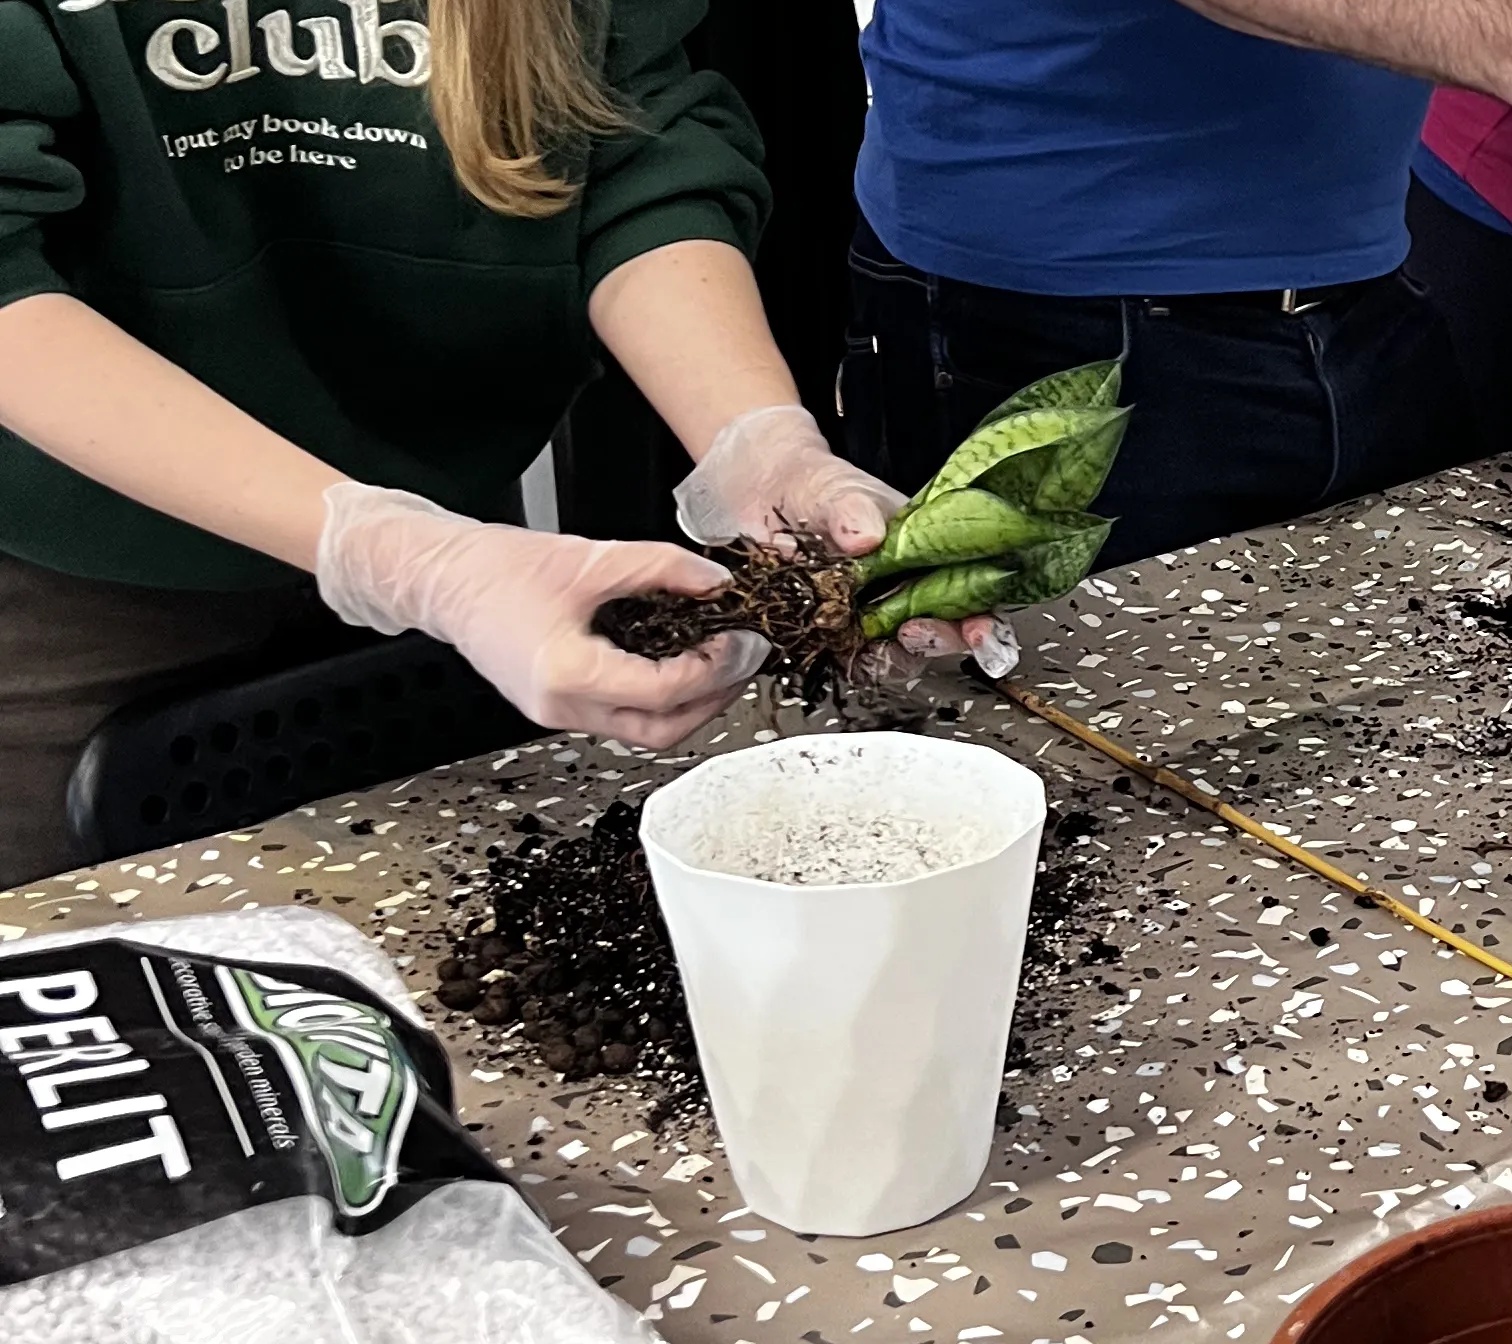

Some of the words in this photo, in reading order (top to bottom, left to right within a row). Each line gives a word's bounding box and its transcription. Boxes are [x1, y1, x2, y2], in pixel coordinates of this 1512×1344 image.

[161, 133, 176, 158] I
[174, 128, 220, 159] put
[222, 118, 258, 142] my
[262, 113, 340, 140] book
[343, 121, 428, 150] down
[223, 154, 244, 173] to
[250, 146, 283, 167] be
[289, 144, 357, 170] here
[0, 969, 192, 1182] PERLIT
[248, 1077, 300, 1151] minerals
